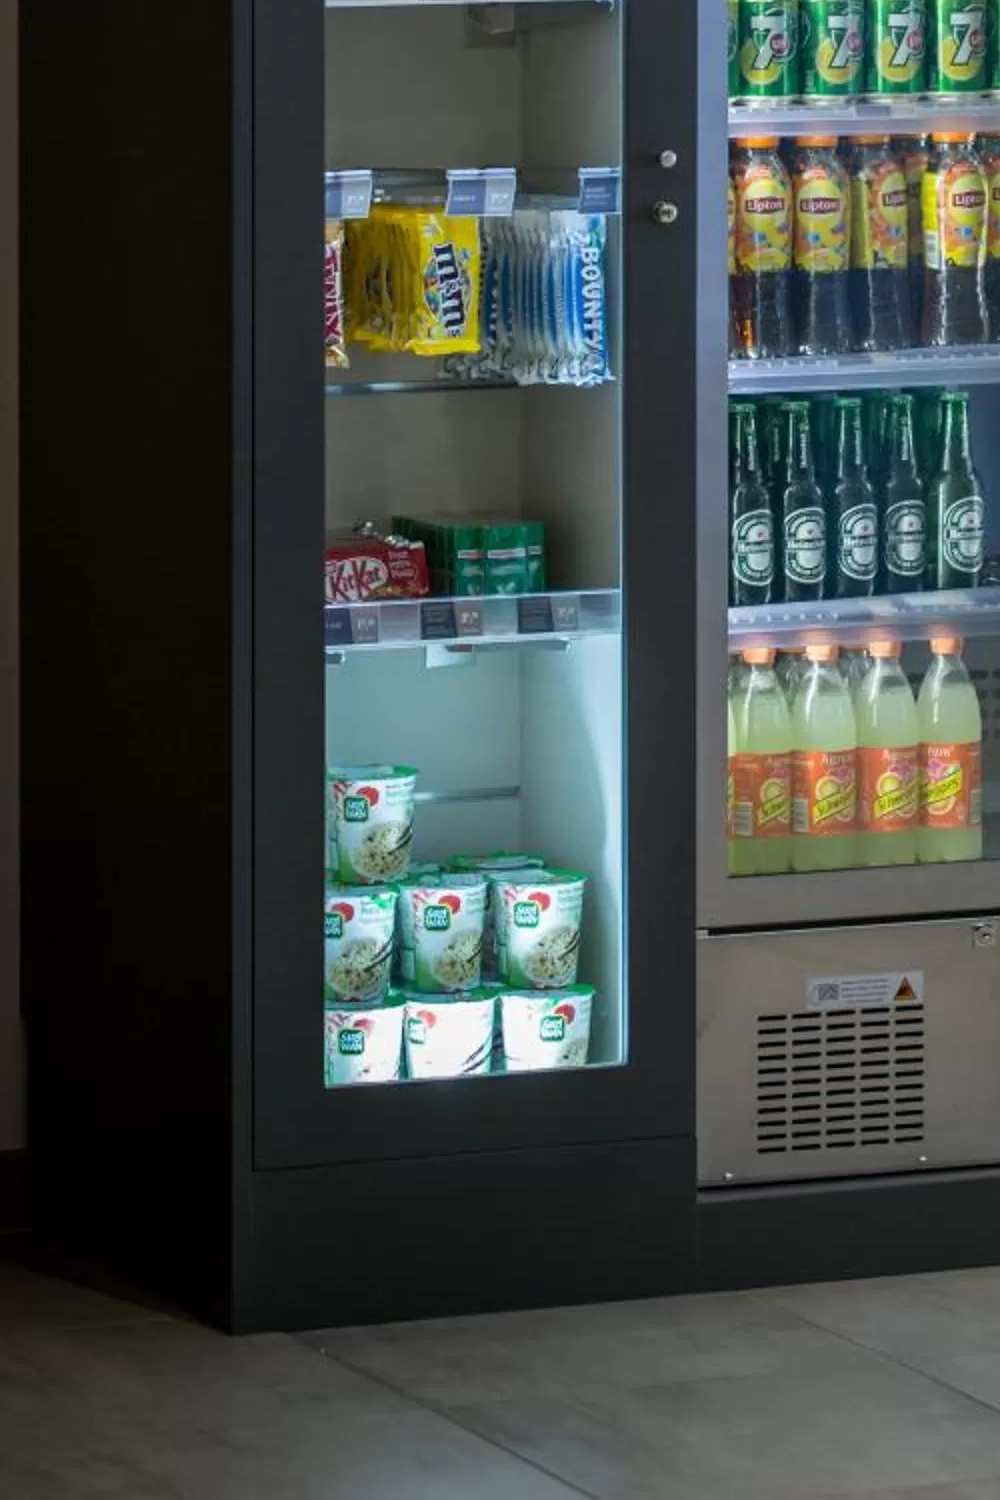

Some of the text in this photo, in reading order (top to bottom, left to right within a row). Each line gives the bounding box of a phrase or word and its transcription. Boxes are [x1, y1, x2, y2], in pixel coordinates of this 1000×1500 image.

[747, 198, 783, 211] Lipton
[802, 198, 839, 212] Lipton
[581, 247, 604, 353] BOUNTY
